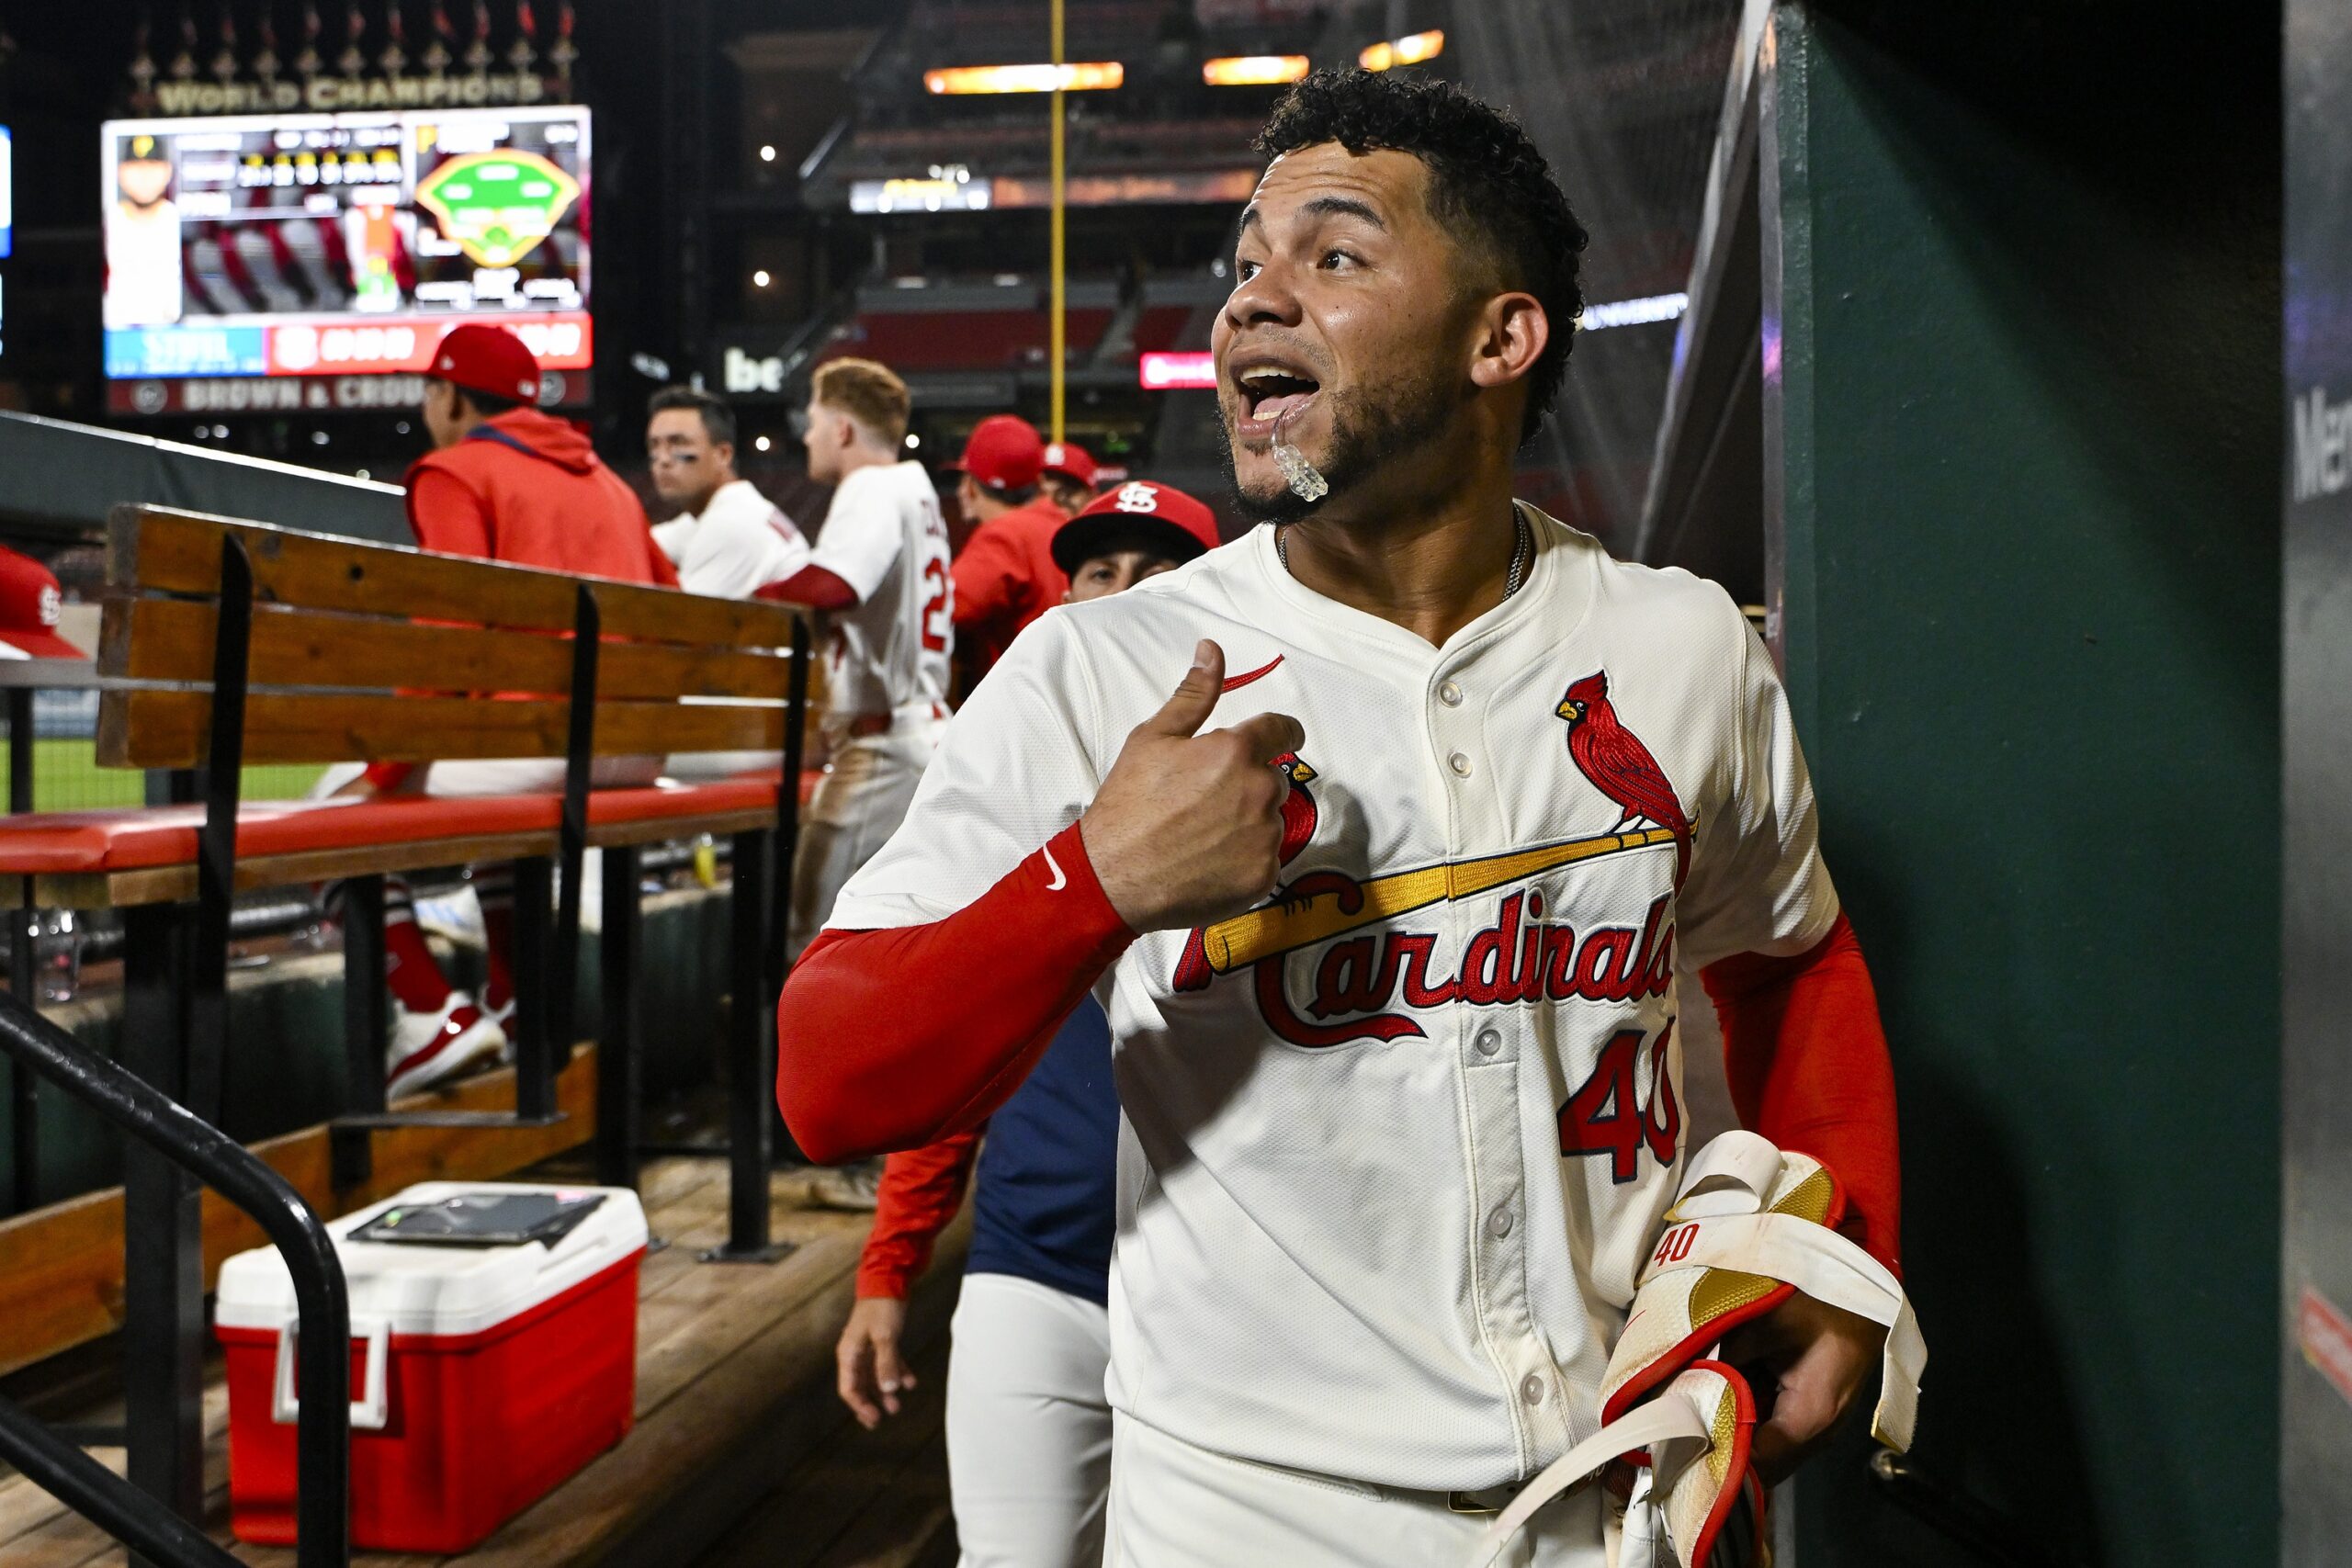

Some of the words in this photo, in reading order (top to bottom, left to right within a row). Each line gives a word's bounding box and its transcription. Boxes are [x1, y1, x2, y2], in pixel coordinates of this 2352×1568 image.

[183, 378, 301, 412] BROWN
[334, 376, 425, 408] CROU
[922, 557, 947, 652] 2
[1253, 871, 1674, 1048] Cardinals
[1557, 1015, 1680, 1185] 40
[1654, 1223, 1700, 1268] 40
